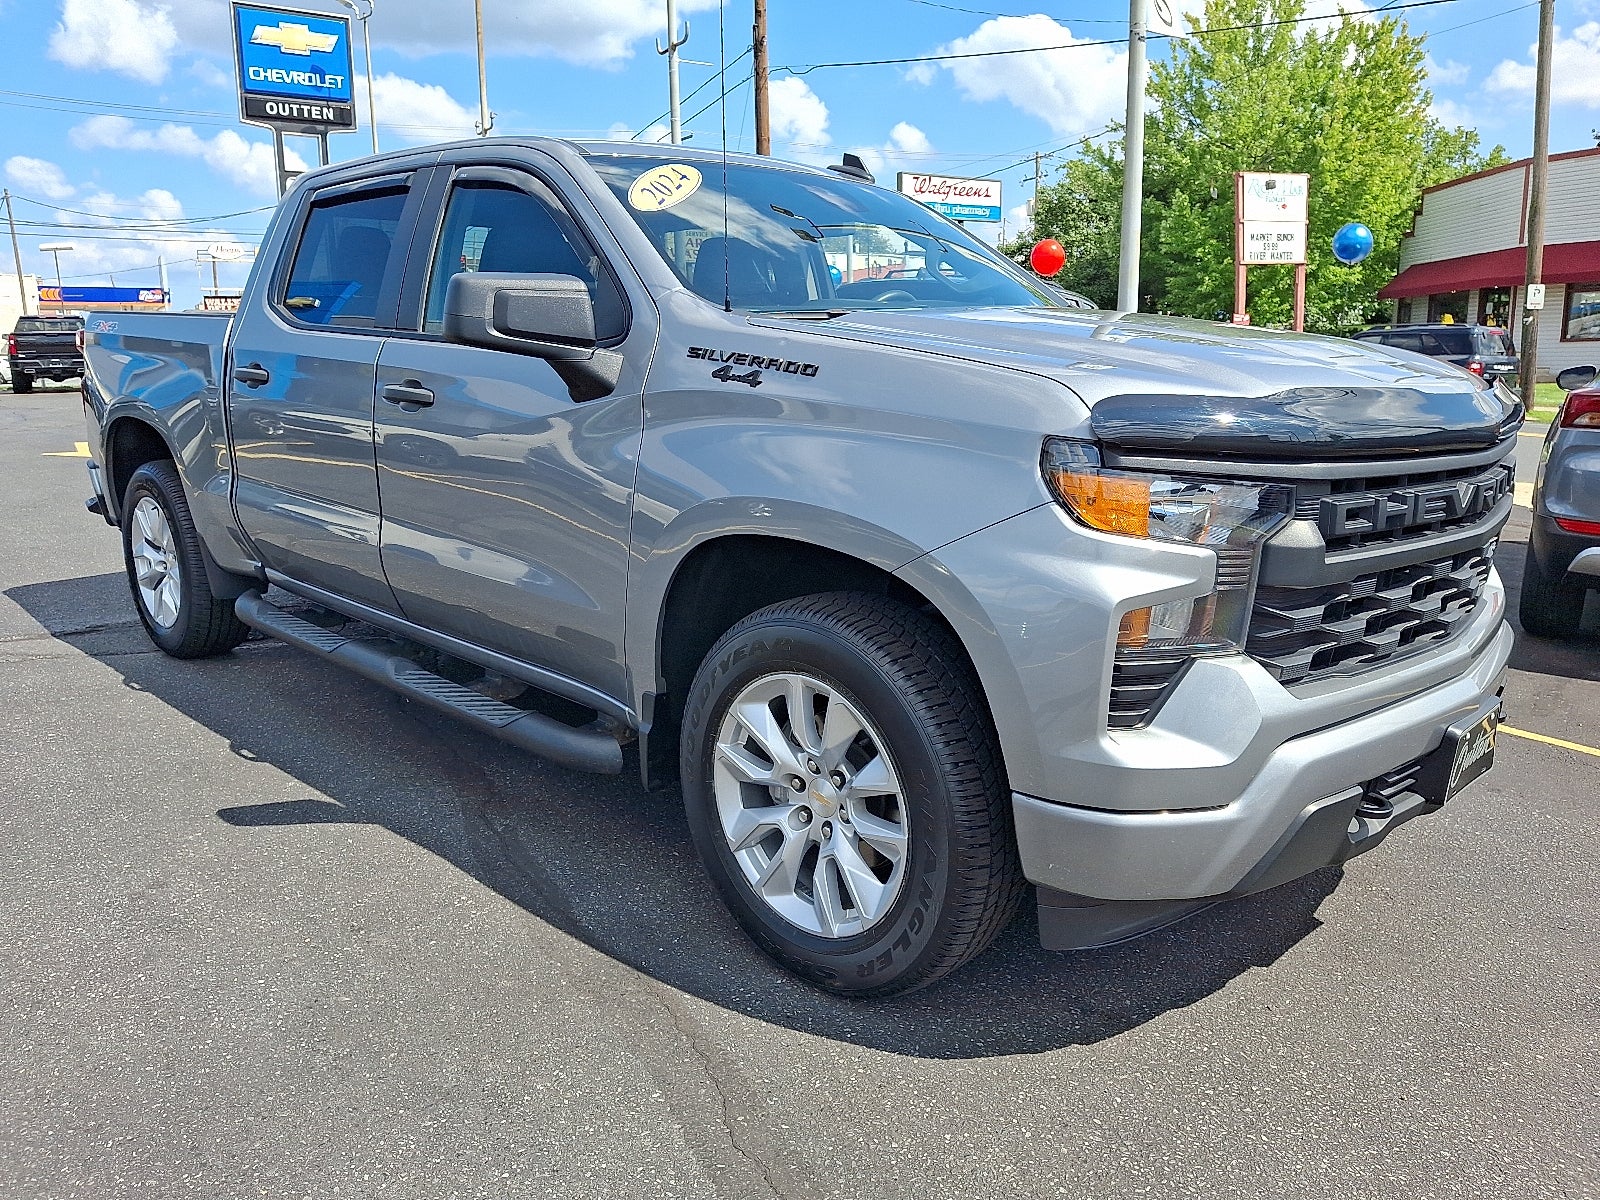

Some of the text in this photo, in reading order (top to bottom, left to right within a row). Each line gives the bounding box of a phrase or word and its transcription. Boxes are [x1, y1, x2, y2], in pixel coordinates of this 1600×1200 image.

[248, 66, 345, 89] CHEVROLET
[265, 101, 334, 120] OUTTEN
[640, 167, 691, 206] 2024
[912, 176, 992, 201] Walgreens
[952, 205, 991, 218] pharmacy
[1250, 233, 1295, 242] MARKET BUNCH
[1270, 251, 1294, 261] WANTED
[686, 346, 820, 378] SILVERADO
